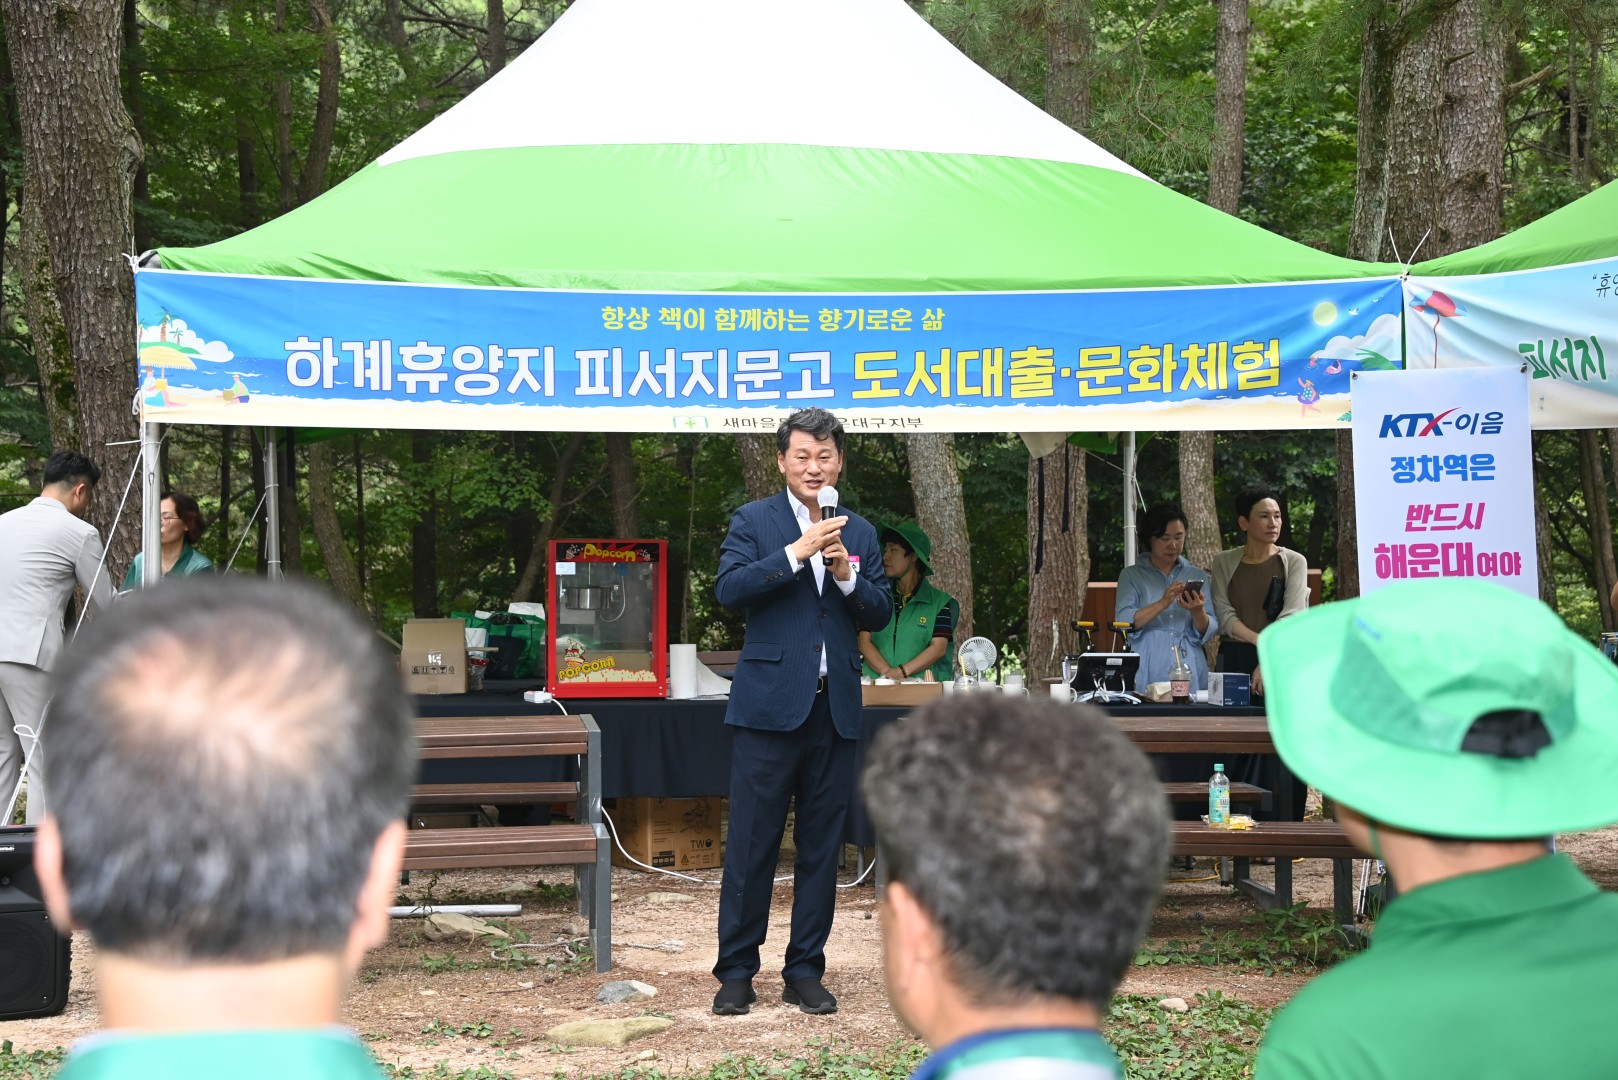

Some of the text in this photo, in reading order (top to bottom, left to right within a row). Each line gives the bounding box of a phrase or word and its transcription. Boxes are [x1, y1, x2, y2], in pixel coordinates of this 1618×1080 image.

[601, 305, 945, 332] 항상 책이 함께하는 향기로운 삶
[284, 336, 1280, 401] 하계휴양지 피서지문고 도서대출·문화체험
[1518, 335, 1607, 381] 피서지
[723, 417, 788, 429] 새마을
[1378, 406, 1504, 438] KTX-이음
[1390, 453, 1496, 484] 정차역은
[1405, 502, 1486, 532] 반드시
[583, 543, 637, 562] Popcorn
[558, 655, 616, 680] POPCORN
